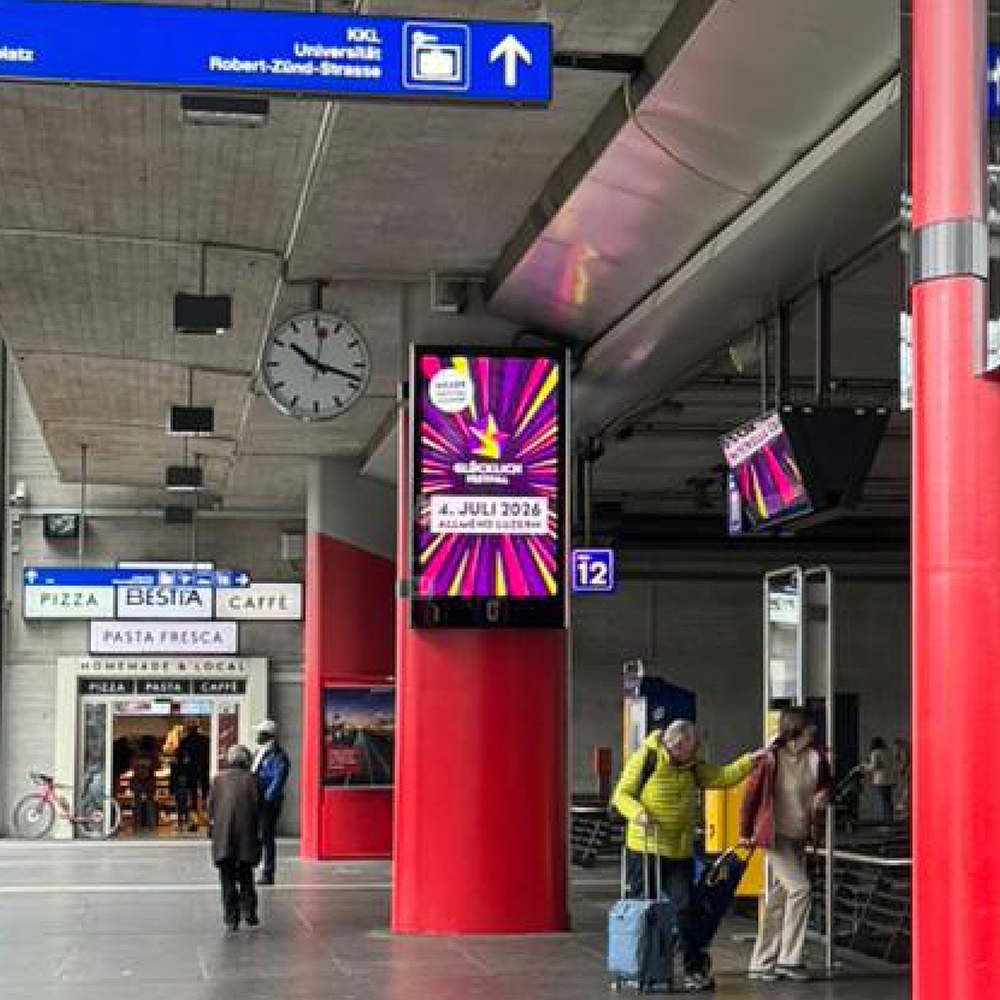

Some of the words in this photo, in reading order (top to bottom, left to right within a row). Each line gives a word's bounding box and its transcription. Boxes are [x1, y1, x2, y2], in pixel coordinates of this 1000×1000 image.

[459, 501, 496, 516] JULI
[577, 561, 608, 585] 12
[39, 591, 100, 607] PIZZA
[125, 587, 203, 606] BESTIA
[102, 630, 155, 645] PASTA
[160, 630, 224, 645] FRESCA
[194, 660, 247, 673] LOCAL
